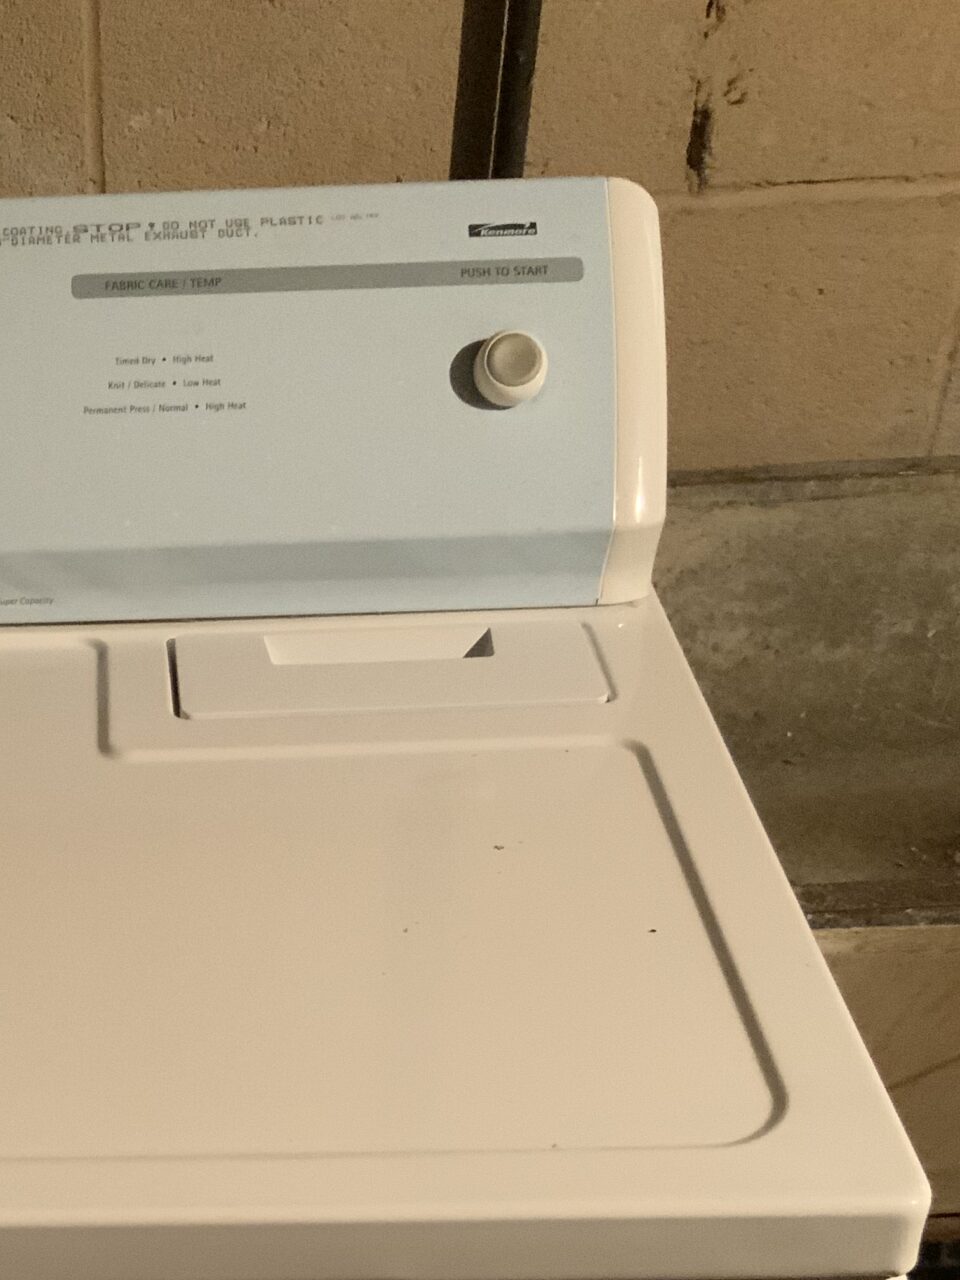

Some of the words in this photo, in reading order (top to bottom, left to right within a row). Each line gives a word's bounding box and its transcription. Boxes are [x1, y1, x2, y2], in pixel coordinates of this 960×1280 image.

[189, 219, 216, 229] NOT
[225, 218, 250, 228] USE
[260, 215, 323, 226] PLASTIC
[90, 232, 135, 243] METAL
[144, 229, 206, 241] EXHAUST
[460, 268, 491, 278] PUSH
[495, 267, 510, 276] TO
[513, 265, 549, 276] START
[104, 281, 145, 291] FABRIC
[148, 280, 179, 290] CARE
[190, 277, 223, 288] TEMP
[115, 357, 139, 365] Timed
[142, 356, 156, 365] Dry
[172, 355, 192, 364] High
[108, 381, 125, 390] Knit
[133, 380, 166, 388] Delicate
[183, 379, 199, 387] Low
[202, 378, 221, 386] Heat
[83, 406, 126, 414] Permanent
[130, 405, 150, 413] Press
[159, 404, 188, 412] Normal
[206, 402, 224, 411] High
[227, 401, 246, 409] Heat
